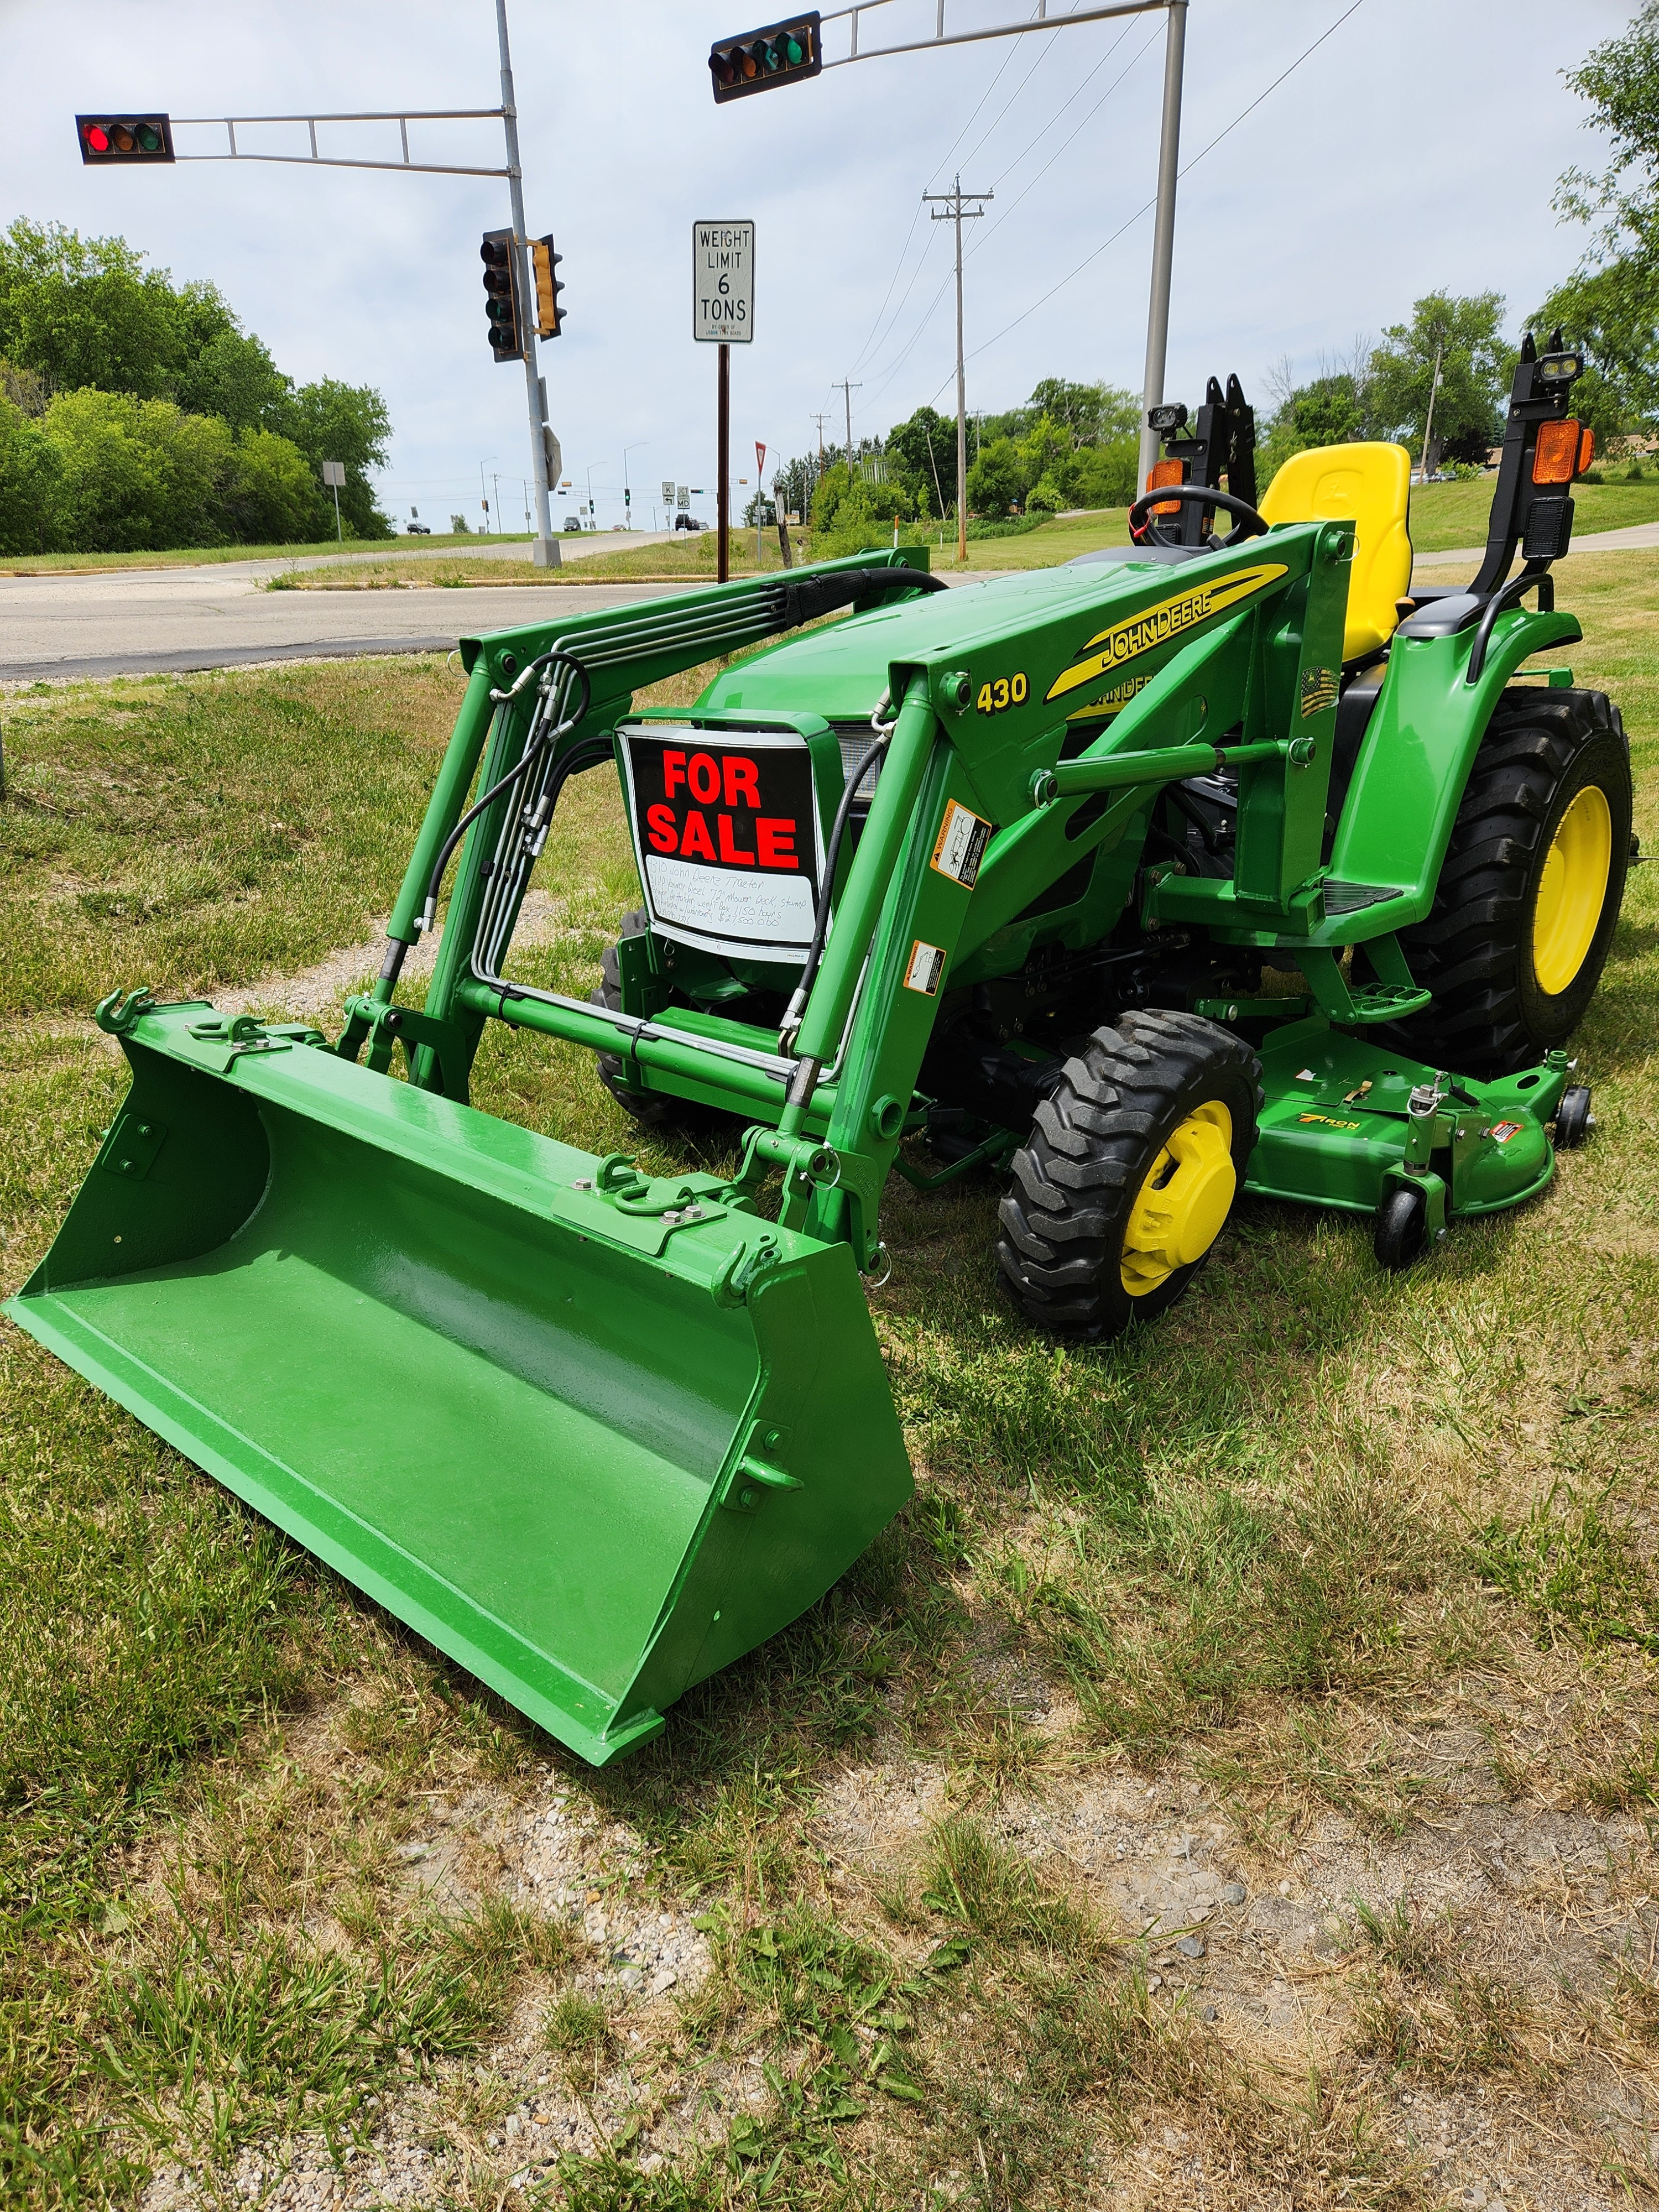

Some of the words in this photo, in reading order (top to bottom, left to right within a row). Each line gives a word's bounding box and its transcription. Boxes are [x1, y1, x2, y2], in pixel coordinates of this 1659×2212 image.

[700, 230, 749, 247] WEIGHT
[708, 252, 742, 268] LIMIT
[718, 273, 729, 295] 6
[701, 299, 746, 321] TONS
[1102, 624, 1156, 667] JOHN
[1156, 589, 1212, 637] DEERE
[977, 671, 1030, 716] 430
[664, 750, 761, 808] FOR
[647, 804, 799, 869] SALE
[937, 808, 952, 849] WARNING
[647, 857, 667, 874] 4310
[670, 864, 690, 878] John
[692, 868, 721, 886] Deere
[726, 876, 764, 890] Tractor
[725, 893, 752, 903] Mower
[718, 910, 754, 926] $27,500
[734, 906, 755, 916] 1150
[758, 905, 782, 919] hours
[908, 946, 917, 974] WARNING
